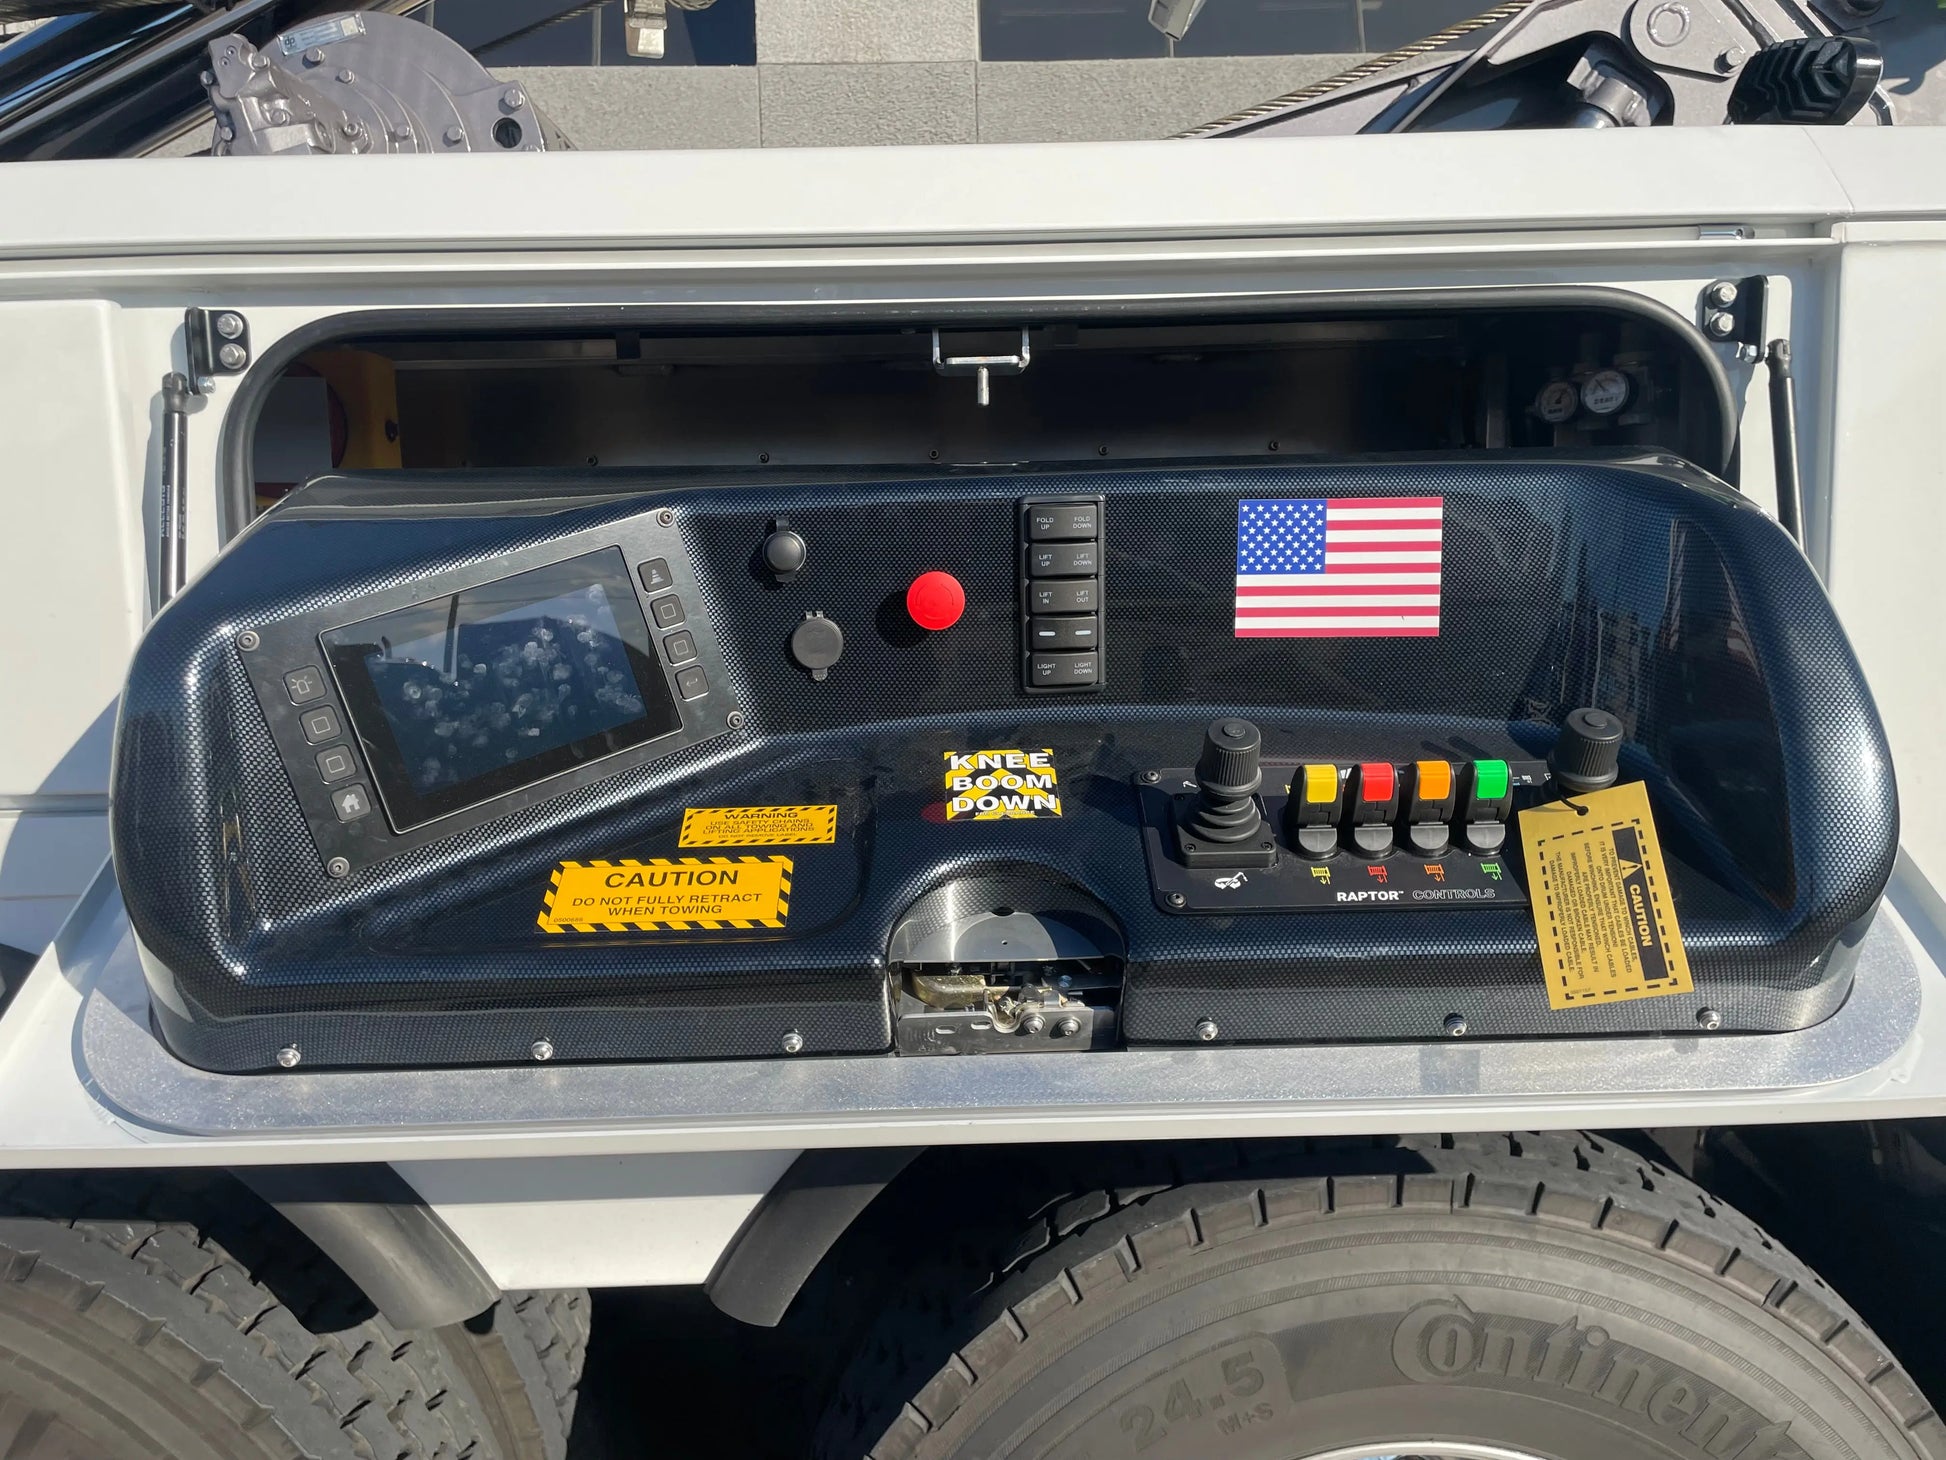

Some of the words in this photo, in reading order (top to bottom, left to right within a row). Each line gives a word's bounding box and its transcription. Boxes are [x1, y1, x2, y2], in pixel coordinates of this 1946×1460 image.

[950, 752, 1050, 770] KNEE
[952, 774, 1053, 791] BOOM
[952, 794, 1057, 812] DOWN
[724, 812, 798, 820] WARNING
[1554, 851, 1562, 862] THE
[1583, 842, 1592, 863] BEFORE
[1600, 852, 1609, 867] VERY
[1569, 851, 1581, 885] IMPROPERLY
[1581, 871, 1589, 882] ARE
[1595, 865, 1604, 881] ONTO
[1609, 855, 1620, 881] PREVENT
[604, 870, 739, 889] CAUTION
[1556, 862, 1570, 906] MANUFACTURER
[1598, 881, 1608, 899] DRUM
[1603, 866, 1616, 899] IMPORTANT
[572, 897, 595, 907] DO
[600, 896, 633, 906] NOT
[636, 895, 684, 905] FULLY
[689, 893, 762, 903] RETRACT
[1412, 888, 1496, 900] CONTROLS
[1565, 870, 1576, 898] DAMAGED
[1572, 907, 1583, 931] BROKEN
[1576, 885, 1586, 909] LOADED
[1583, 882, 1594, 912] PROPERLY
[1614, 881, 1626, 906] DAMAGE
[608, 906, 656, 916] WHEN
[660, 905, 723, 915] TOWING
[1548, 859, 1558, 882] DAMAGE
[1554, 891, 1566, 926] IMPROPERLY
[1560, 926, 1571, 950] LOADED
[1593, 893, 1603, 916] ENSURE
[1602, 899, 1612, 920] UNDER
[1610, 899, 1619, 914] THAT
[1565, 912, 1574, 925] NOT
[1580, 908, 1590, 928] CABLE
[1598, 917, 1606, 932] THAT
[1613, 914, 1624, 938] CABLES
[1622, 915, 1632, 936] WINCH
[1629, 884, 1653, 948] CAUTION
[1584, 928, 1592, 941] MAY
[1601, 932, 1611, 953] WINCH
[1568, 925, 1581, 966] RESPONSIBLE
[1587, 942, 1597, 964] RESULT
[1605, 953, 1616, 978] CABLES
[1620, 948, 1632, 973] LOADED
[1575, 966, 1584, 979] FOR
[1119, 1351, 1265, 1452] 24.5
[1216, 1402, 1275, 1436] M+S
